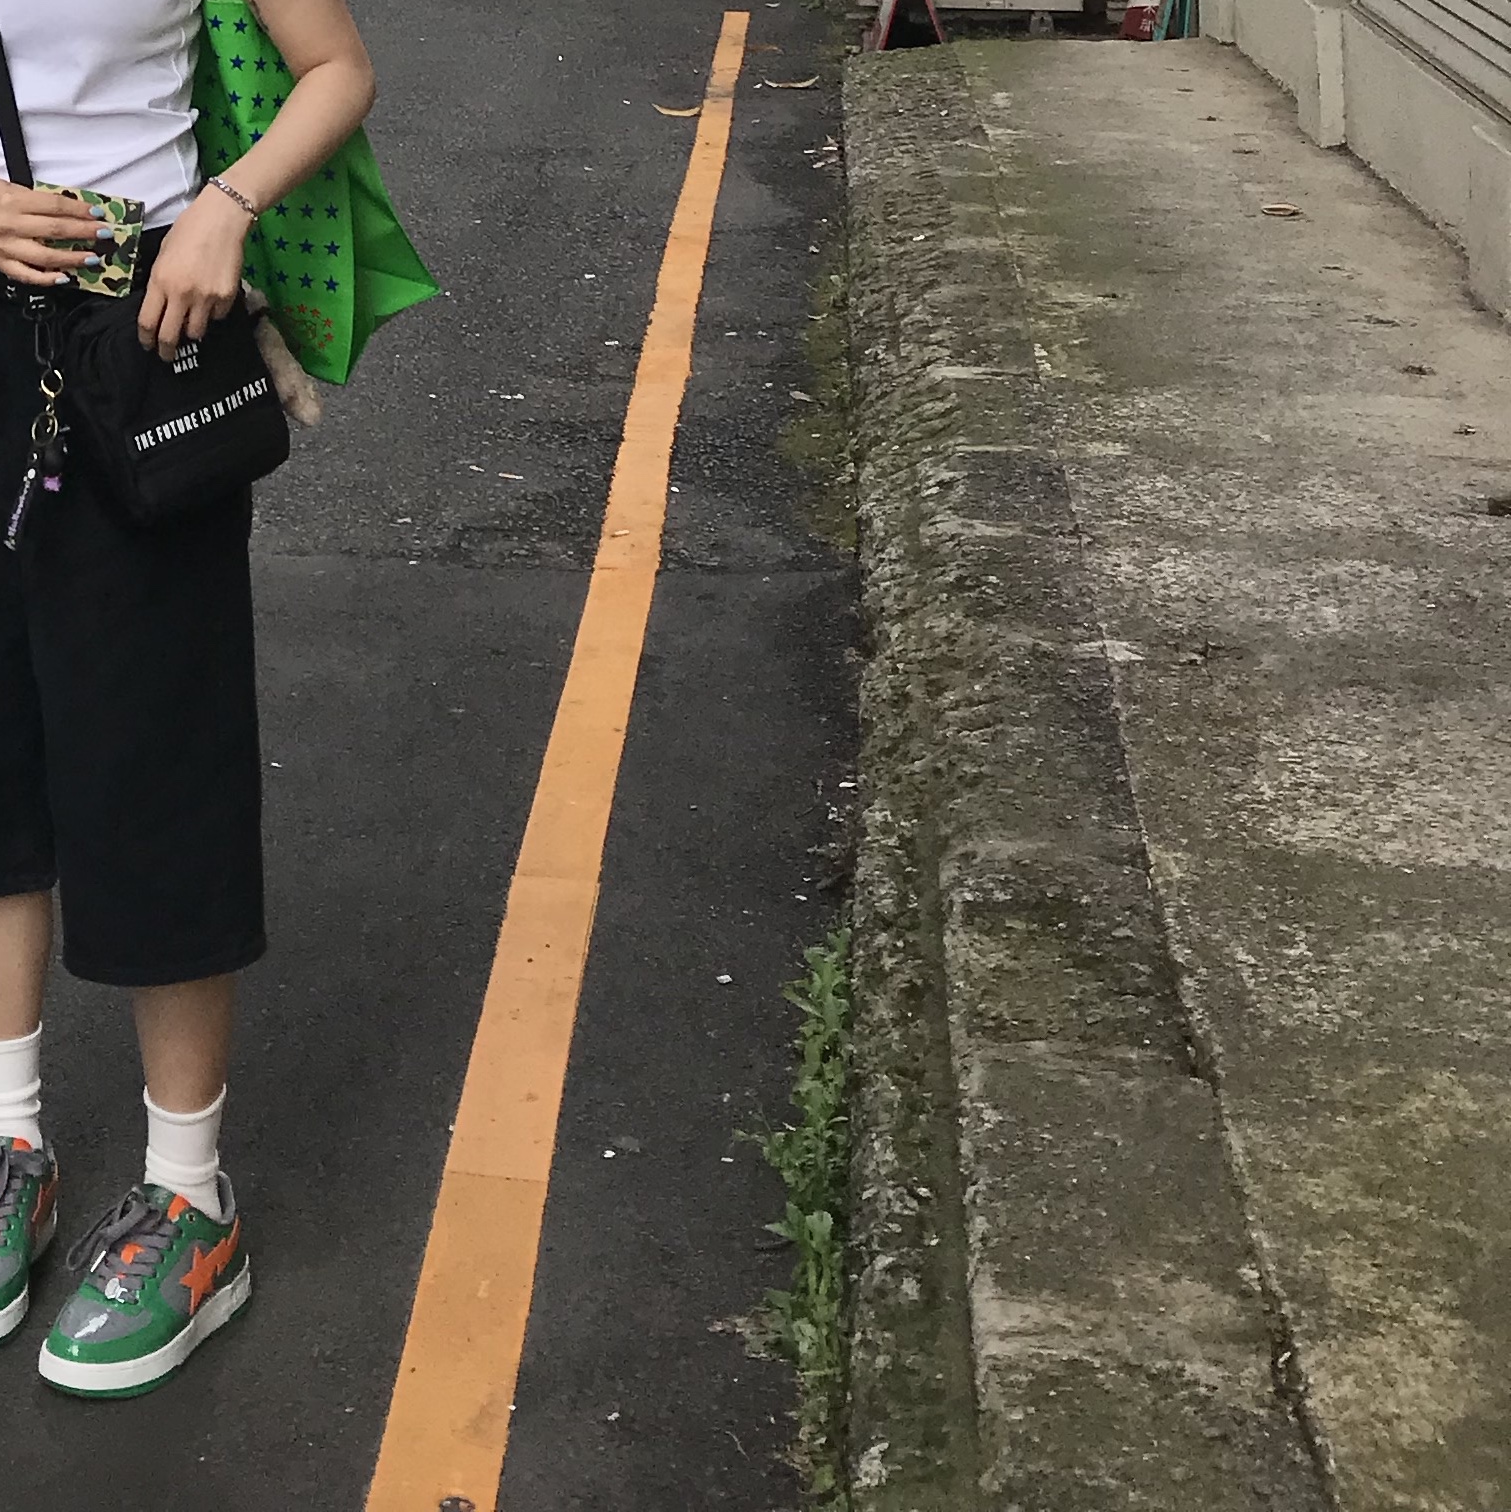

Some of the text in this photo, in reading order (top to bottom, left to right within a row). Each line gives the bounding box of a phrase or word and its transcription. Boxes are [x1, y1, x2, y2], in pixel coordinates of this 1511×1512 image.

[173, 355, 199, 374] MADE
[134, 377, 268, 451] THE FUTURE IS IN THE PAST
